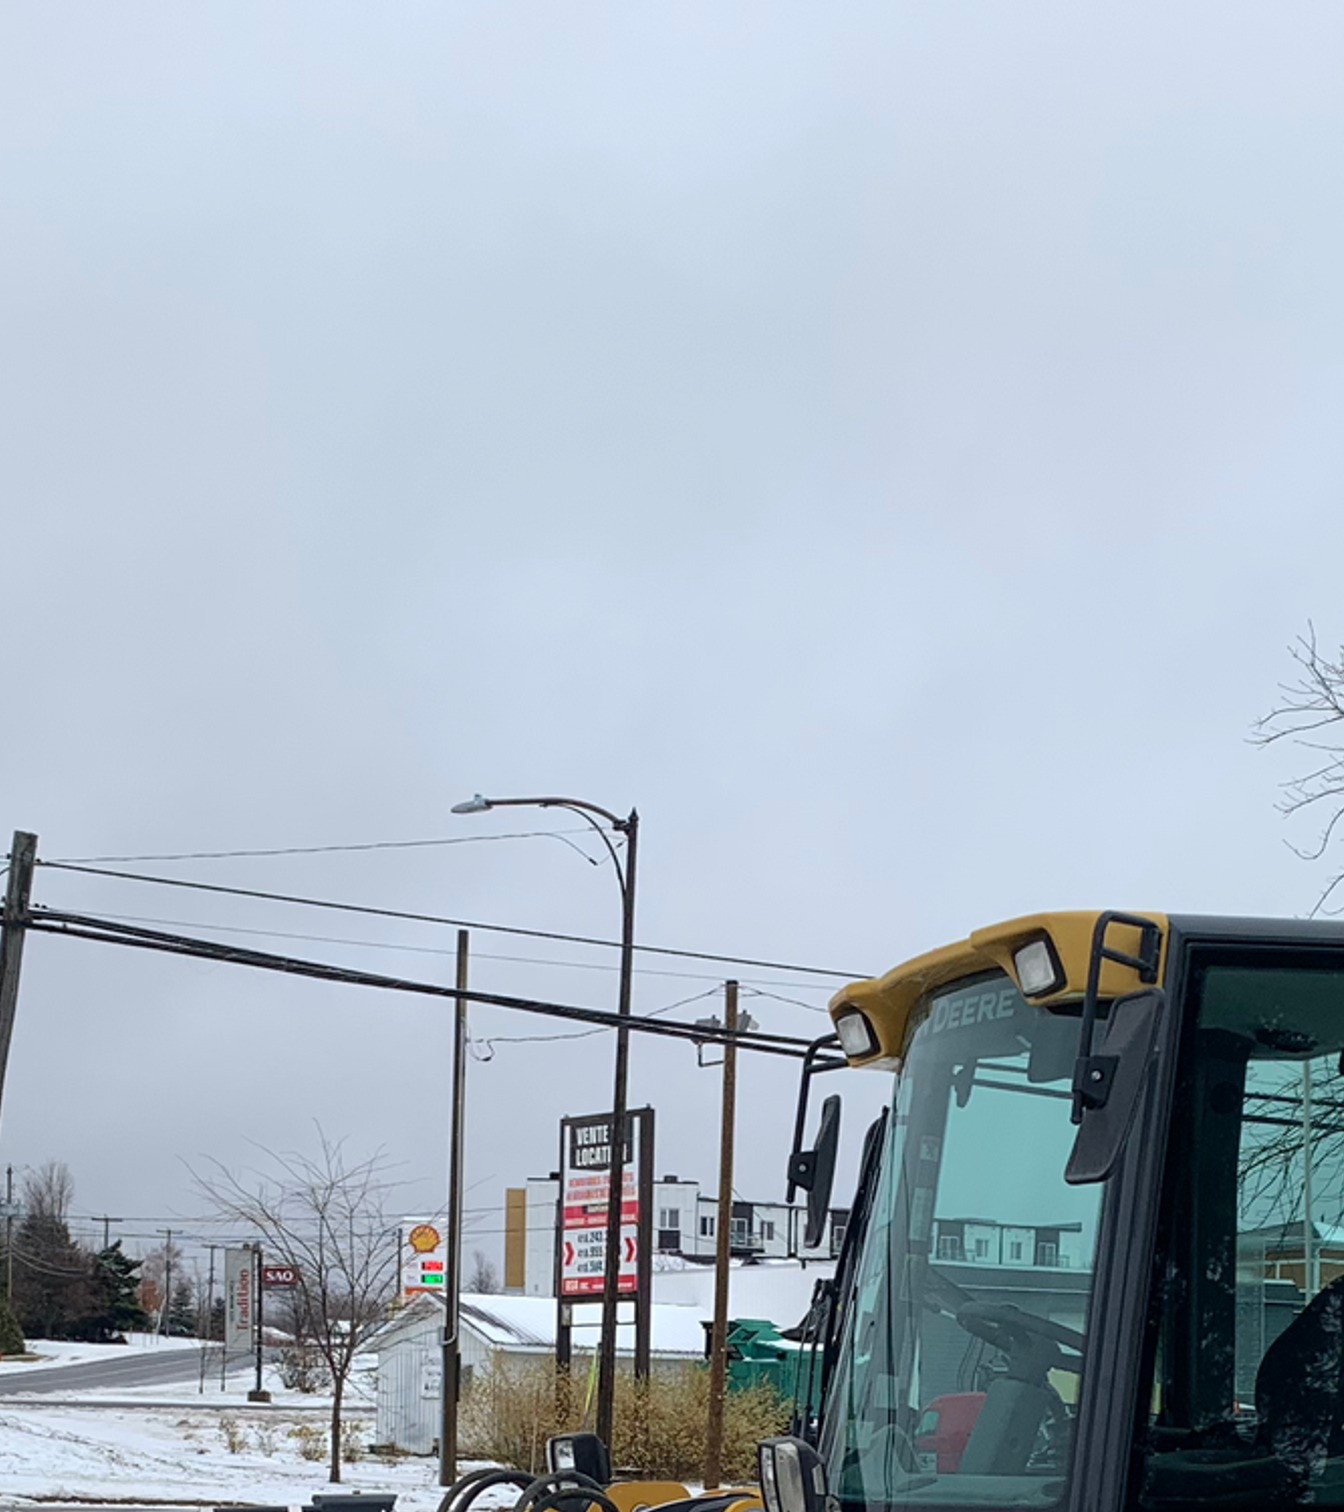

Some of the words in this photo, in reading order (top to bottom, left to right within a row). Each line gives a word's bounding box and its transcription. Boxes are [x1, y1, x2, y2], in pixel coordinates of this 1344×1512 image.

[932, 988, 1017, 1034] DEERE
[576, 1124, 609, 1146] VENTE
[237, 1268, 249, 1330] Tradition
